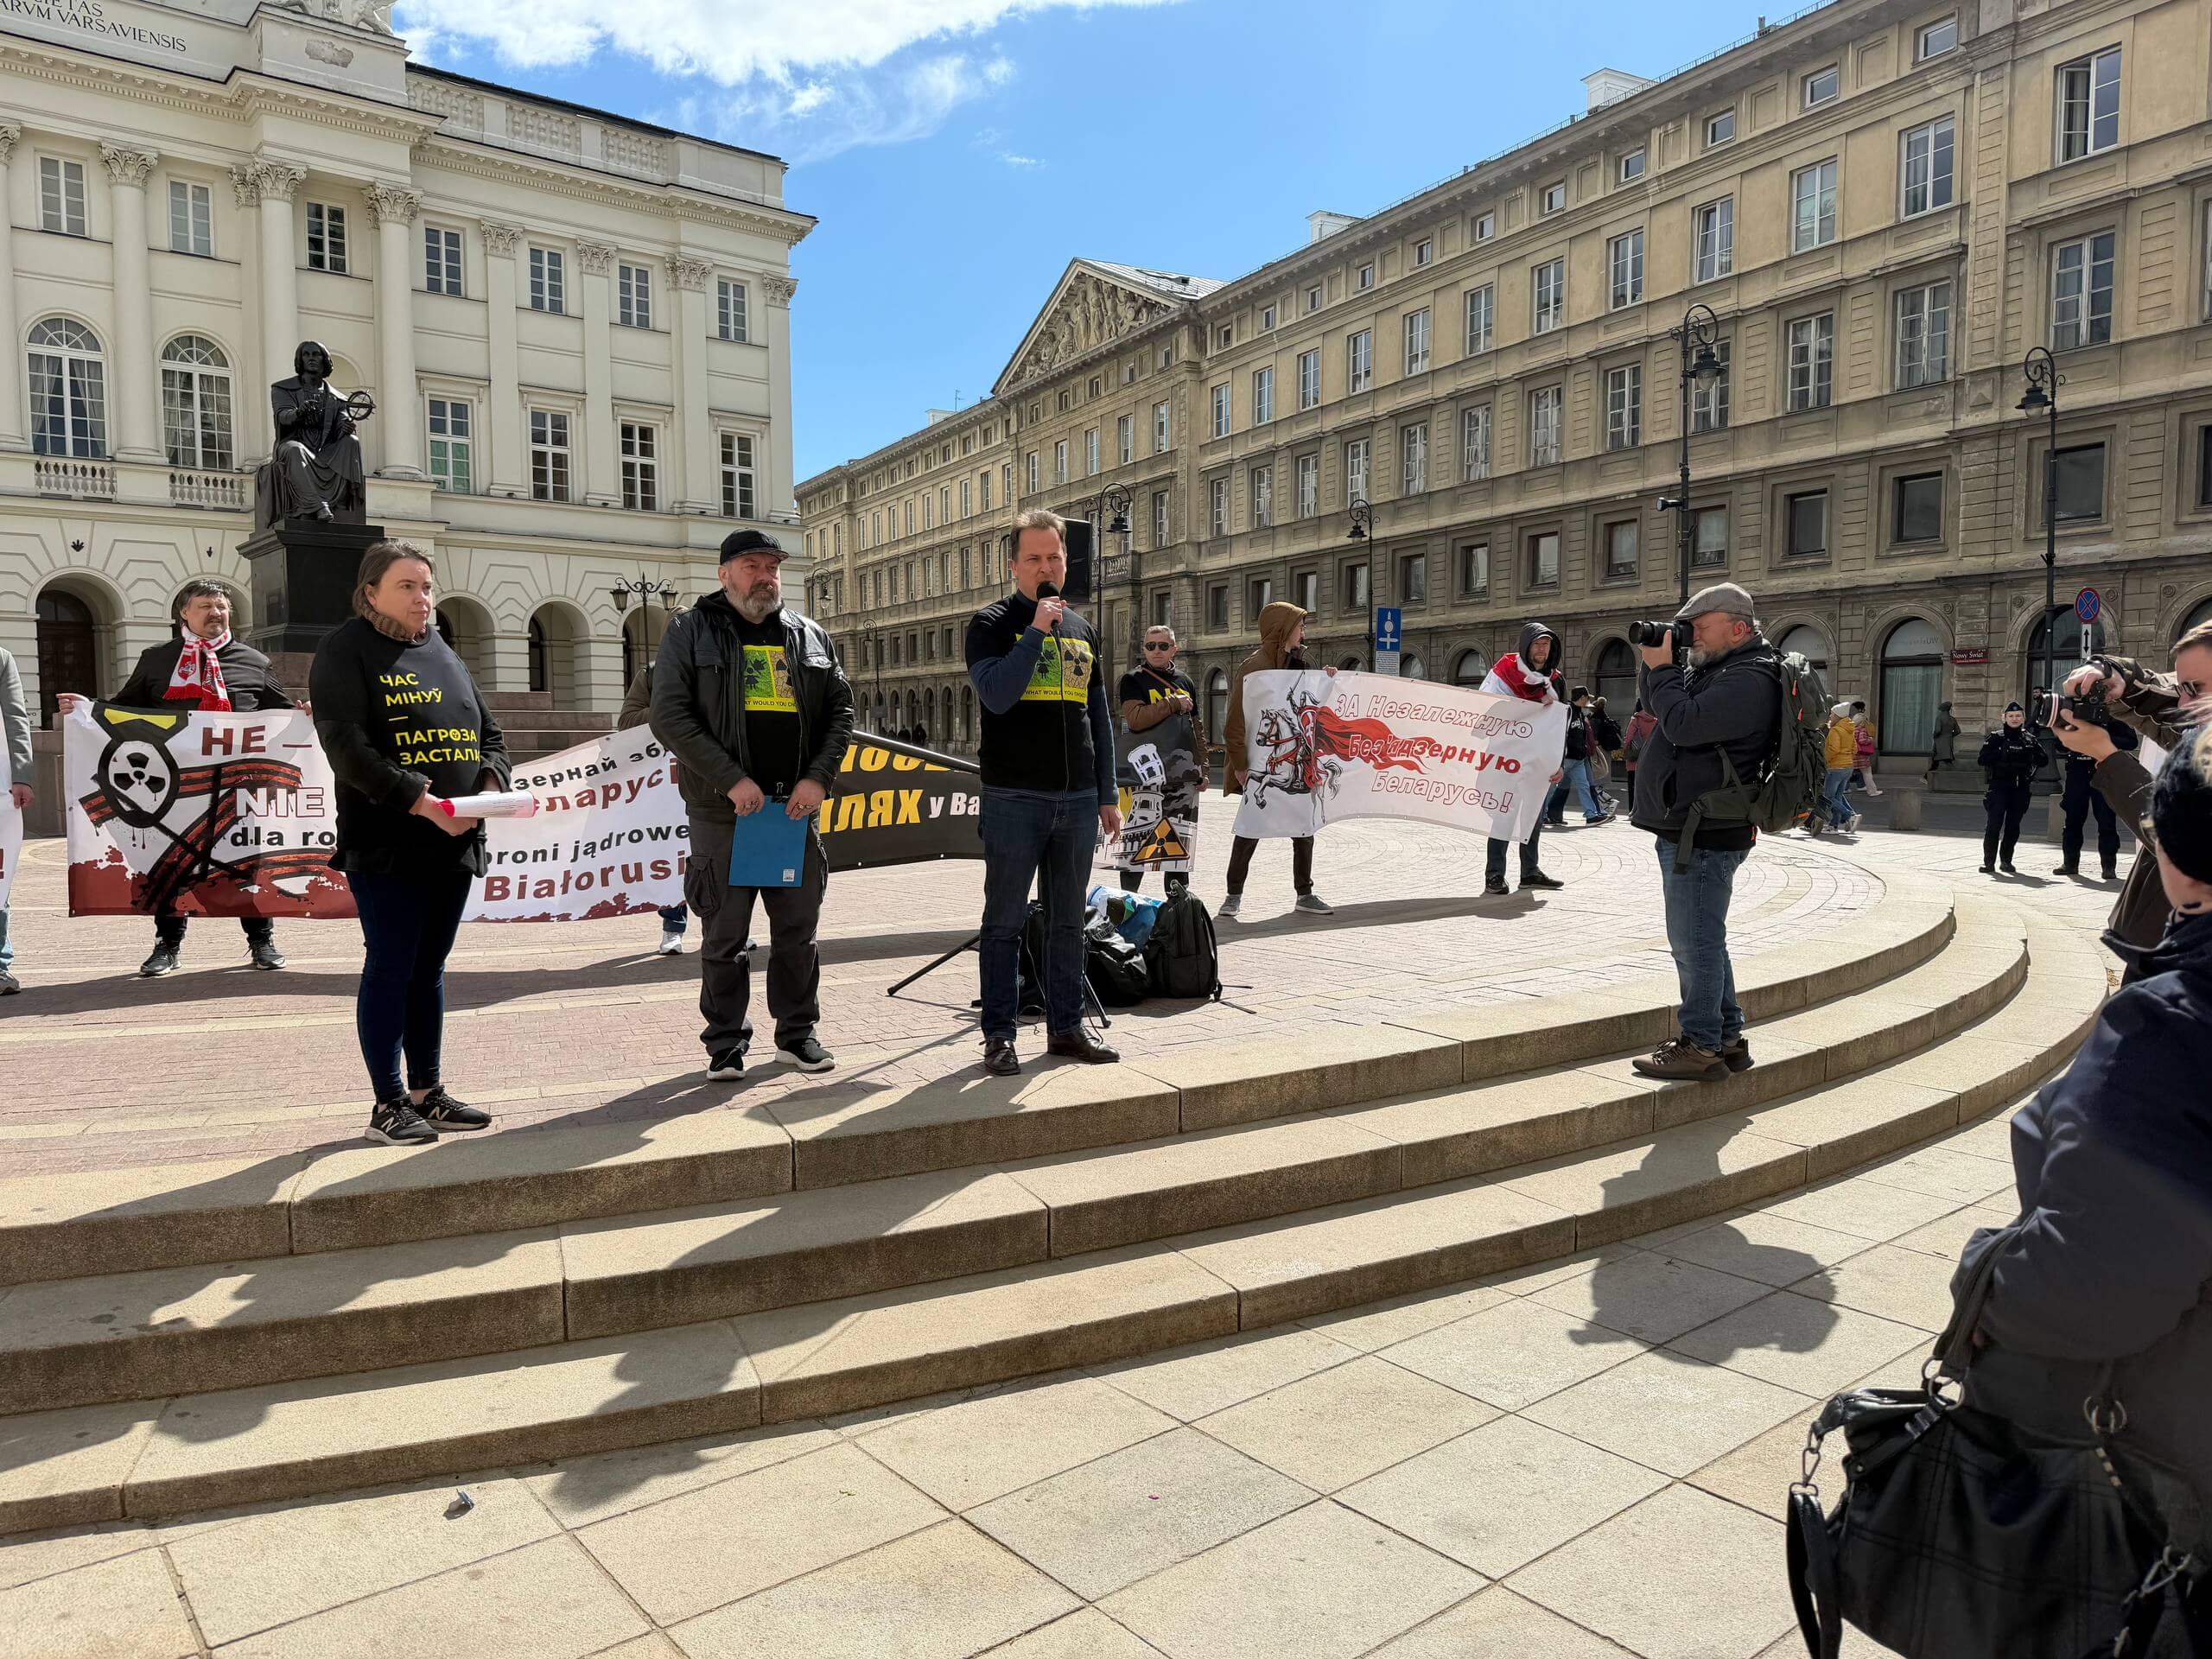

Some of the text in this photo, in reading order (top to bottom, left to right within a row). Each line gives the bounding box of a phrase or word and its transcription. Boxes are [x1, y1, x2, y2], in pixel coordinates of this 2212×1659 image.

[57, 10, 187, 52] VARSAVIENSIS
[379, 673, 419, 687] ЧАС
[385, 688, 442, 707] МІНУЎ
[1335, 694, 1534, 738] ЗА Незалежную
[201, 725, 266, 756] НЕ
[395, 728, 477, 746] ПАГРОЗА
[513, 757, 617, 791] зернай
[236, 787, 325, 817] NIE
[1371, 772, 1513, 813] Беларусь!
[231, 826, 283, 847] dla
[570, 823, 690, 863] jądrowe
[484, 850, 685, 902] Białorusi
